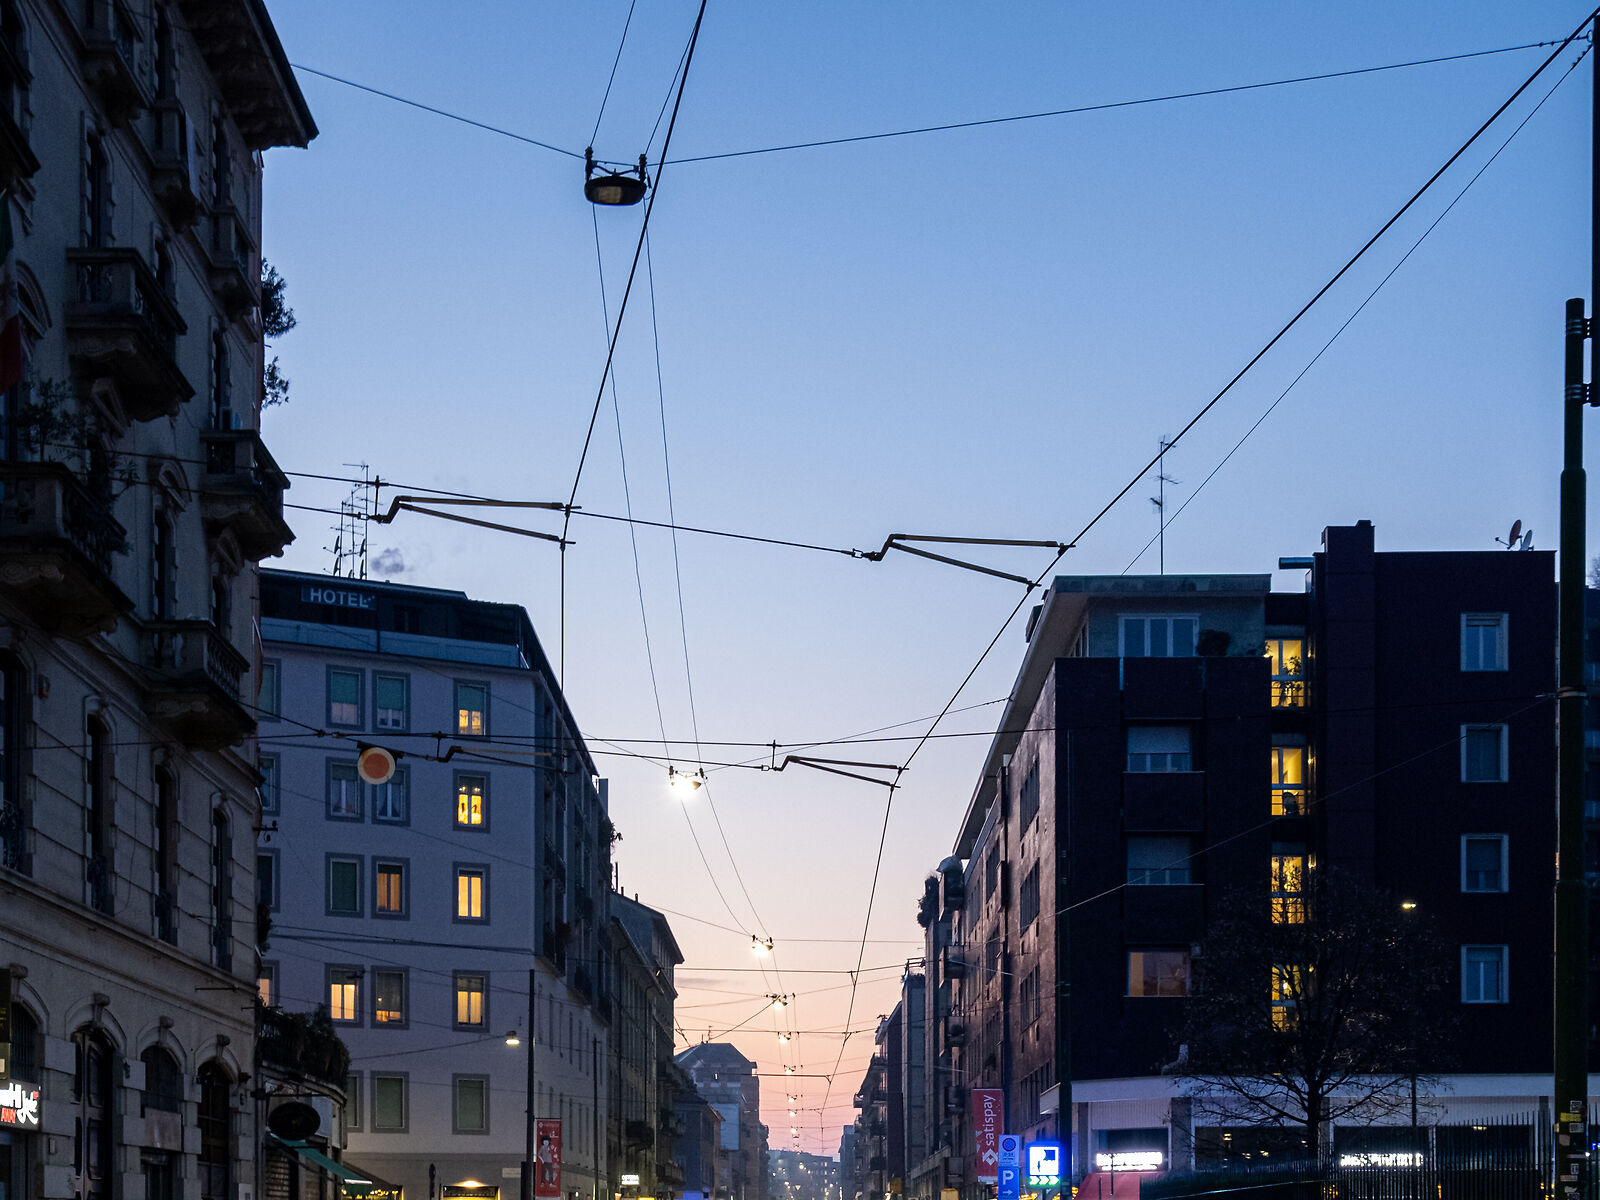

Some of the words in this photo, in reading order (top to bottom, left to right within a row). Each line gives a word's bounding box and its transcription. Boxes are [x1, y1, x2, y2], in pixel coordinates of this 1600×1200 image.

[310, 588, 368, 607] HOTEL
[983, 1095, 997, 1146] satispay
[1003, 1170, 1014, 1185] P
